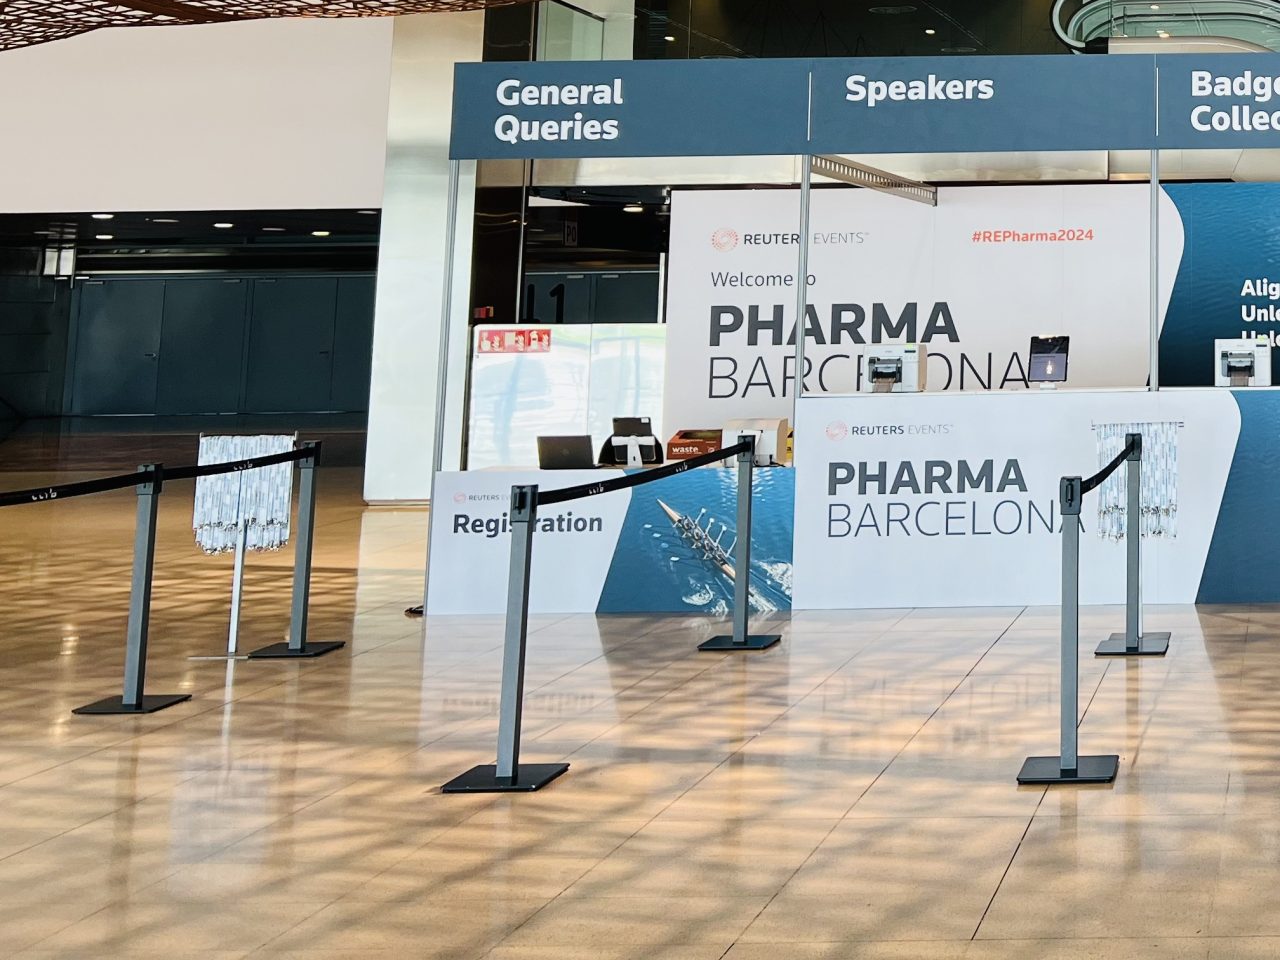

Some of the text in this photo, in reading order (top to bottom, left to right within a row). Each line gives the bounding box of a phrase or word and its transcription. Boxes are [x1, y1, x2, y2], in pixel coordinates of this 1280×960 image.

[496, 78, 623, 106] General
[845, 74, 994, 107] Speakers
[494, 112, 619, 145] Queries
[743, 233, 800, 246] REUTER
[971, 229, 1094, 243] #REPharma2024
[711, 271, 794, 288] Welcome
[709, 301, 961, 347] PHARMA
[708, 352, 1030, 399] BARCONA
[851, 425, 905, 436] REUTERS
[671, 445, 699, 454] waste
[827, 458, 1029, 496] PHARMA
[468, 494, 500, 502] REUTERS
[453, 511, 603, 539] Regiration
